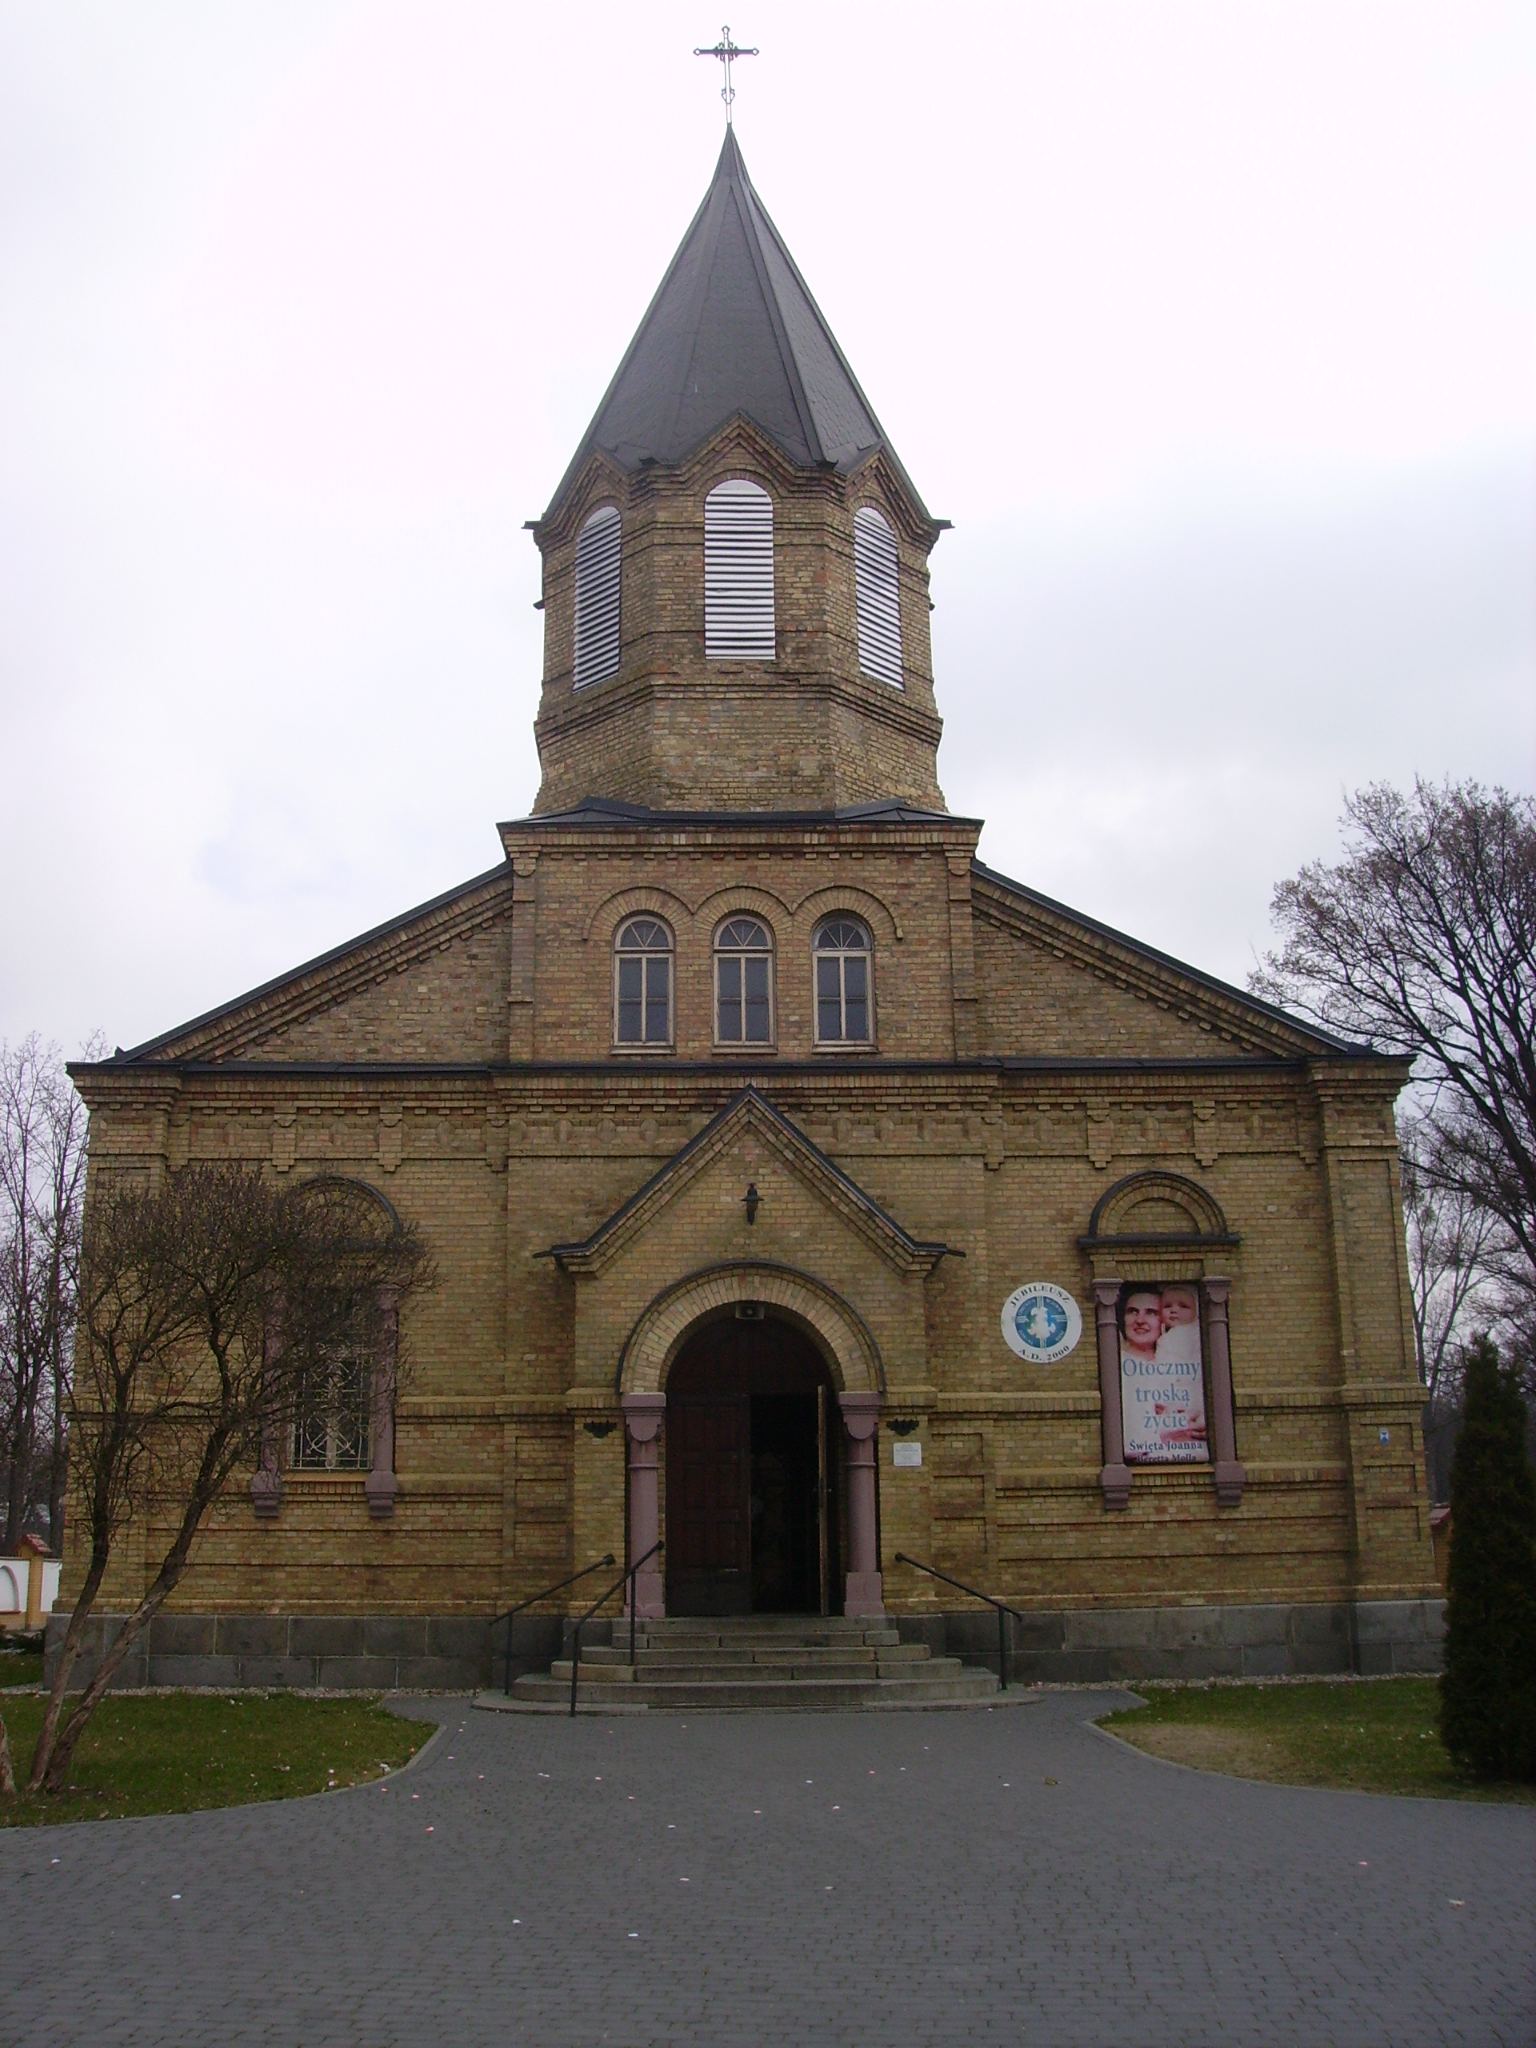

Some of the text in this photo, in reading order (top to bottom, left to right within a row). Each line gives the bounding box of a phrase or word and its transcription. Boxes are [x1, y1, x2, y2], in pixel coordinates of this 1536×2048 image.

[1010, 1285, 1071, 1306] JUBILEUSZ
[1018, 1345, 1070, 1361] A.D. 2000
[1123, 1358, 1201, 1381] Otoczmy
[1135, 1384, 1191, 1407] troską
[1143, 1411, 1187, 1434] życie
[1129, 1439, 1203, 1453] Święta Joanna
